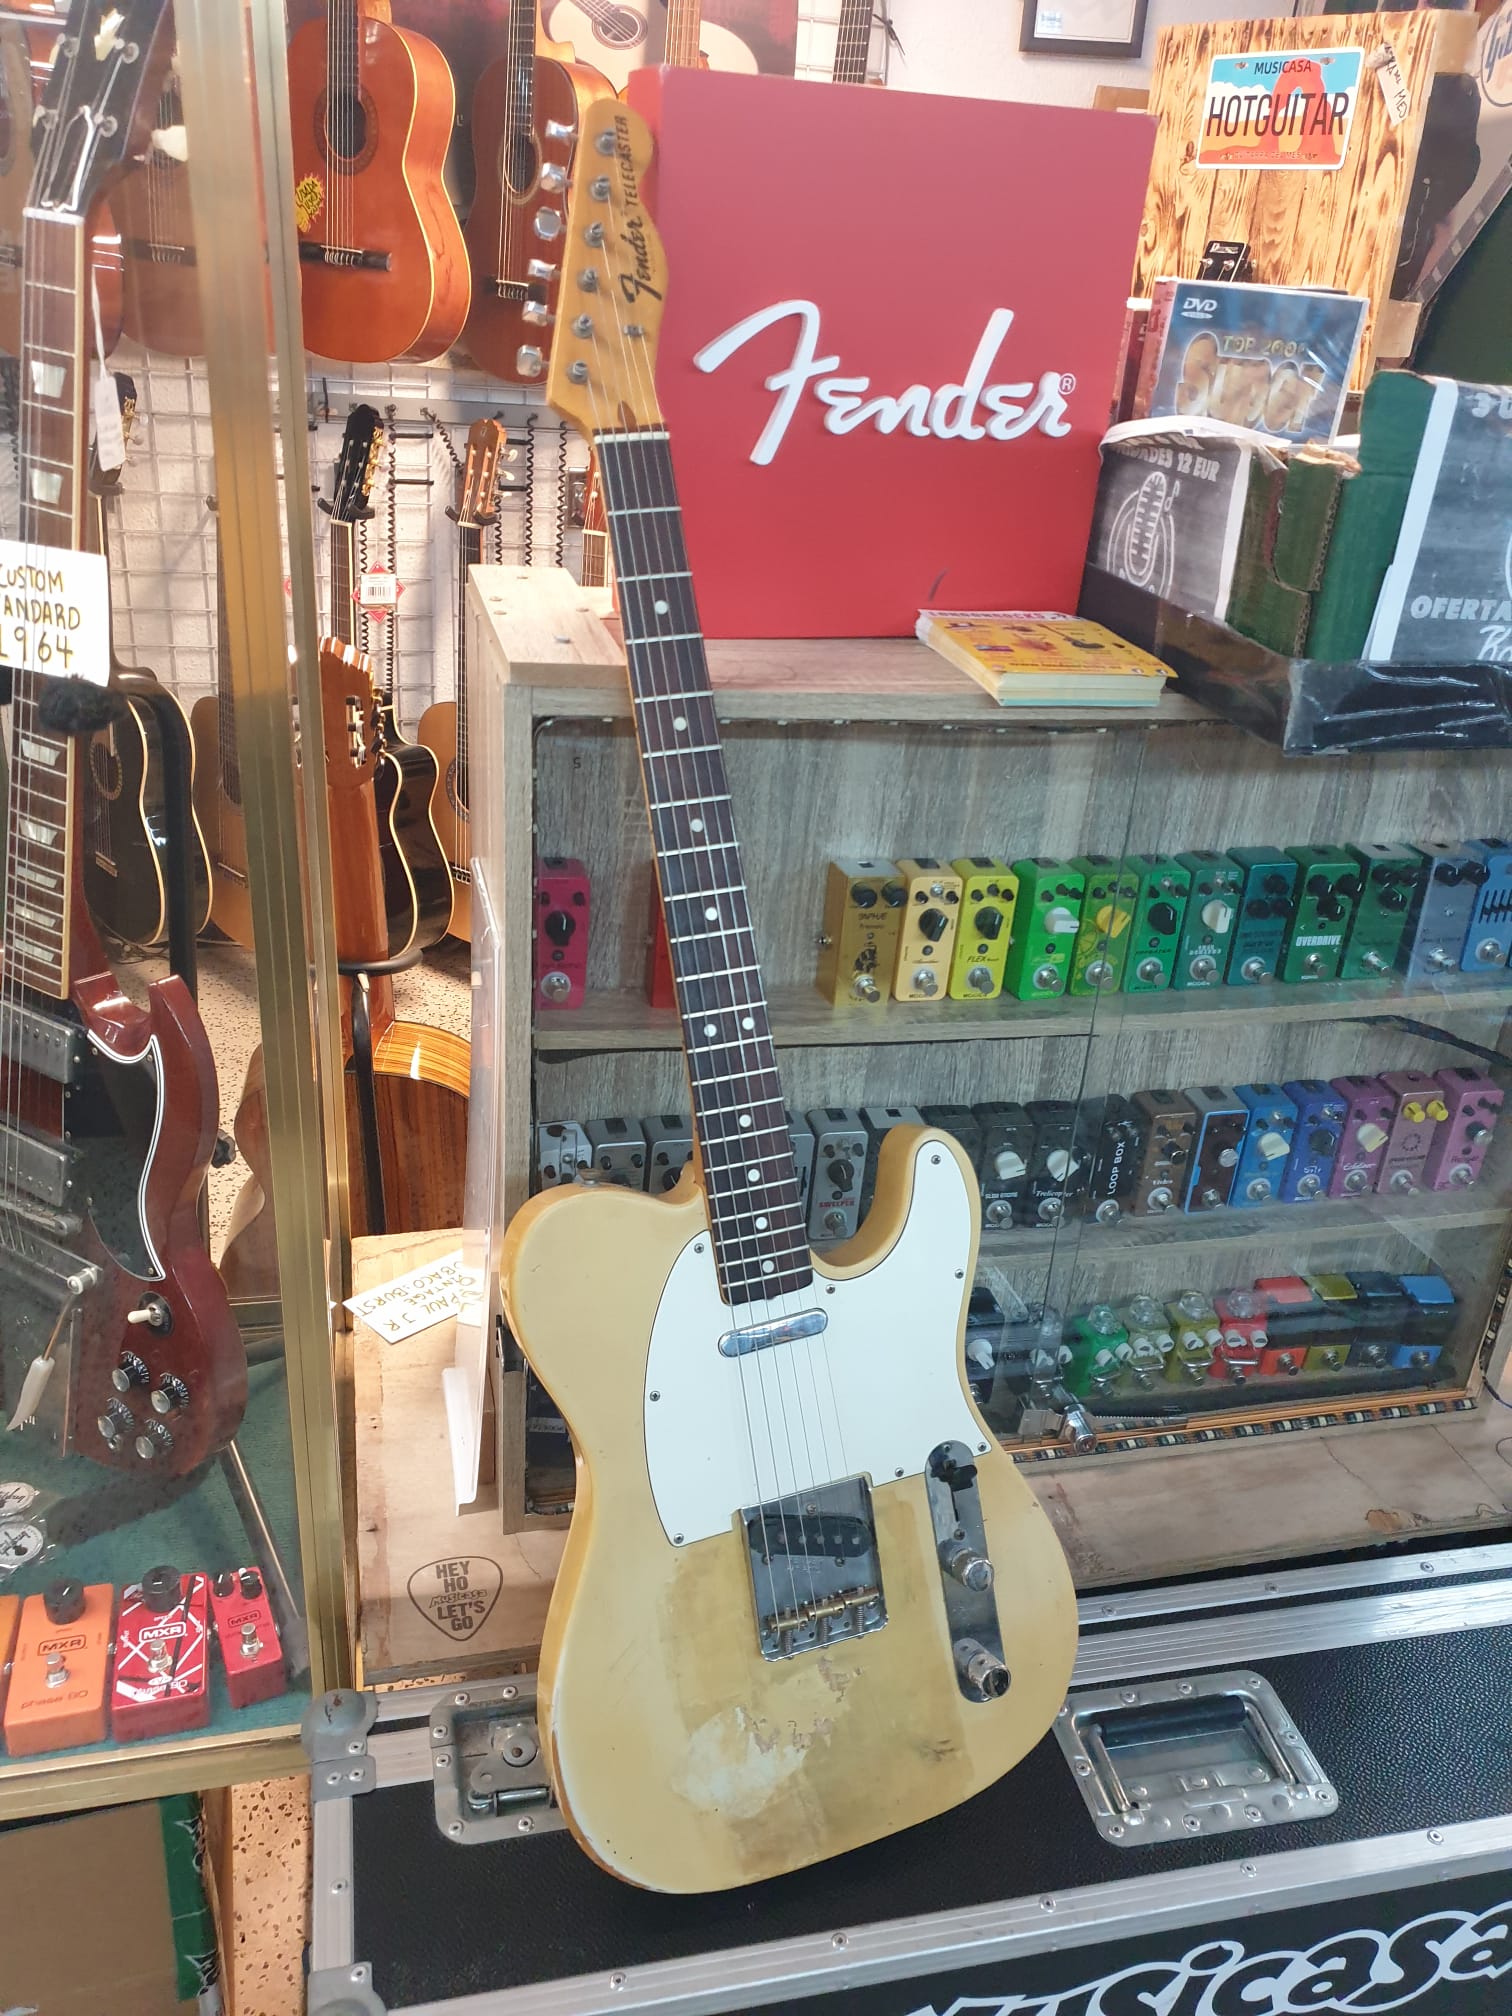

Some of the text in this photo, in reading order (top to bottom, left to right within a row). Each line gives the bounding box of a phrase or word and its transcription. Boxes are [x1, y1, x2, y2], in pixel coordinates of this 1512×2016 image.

[1254, 60, 1312, 75] MUSICASA
[1206, 92, 1350, 137] HOTGUITAR
[614, 115, 663, 303] Fender TELECASTER
[1182, 297, 1218, 312] DVD
[693, 299, 1073, 466] Fender
[1176, 452, 1193, 474] 12
[1193, 456, 1221, 482] EUR
[1295, 935, 1343, 947] OVERDRIVE
[1107, 1141, 1127, 1196] LOOP BOX
[436, 1560, 470, 1579] HEY
[443, 1576, 469, 1593] HO
[437, 1600, 486, 1620] LET'S
[229, 1613, 259, 1626] MXR
[451, 1615, 474, 1631] GO
[142, 1626, 184, 1640] MXR
[41, 1638, 83, 1652] MXR
